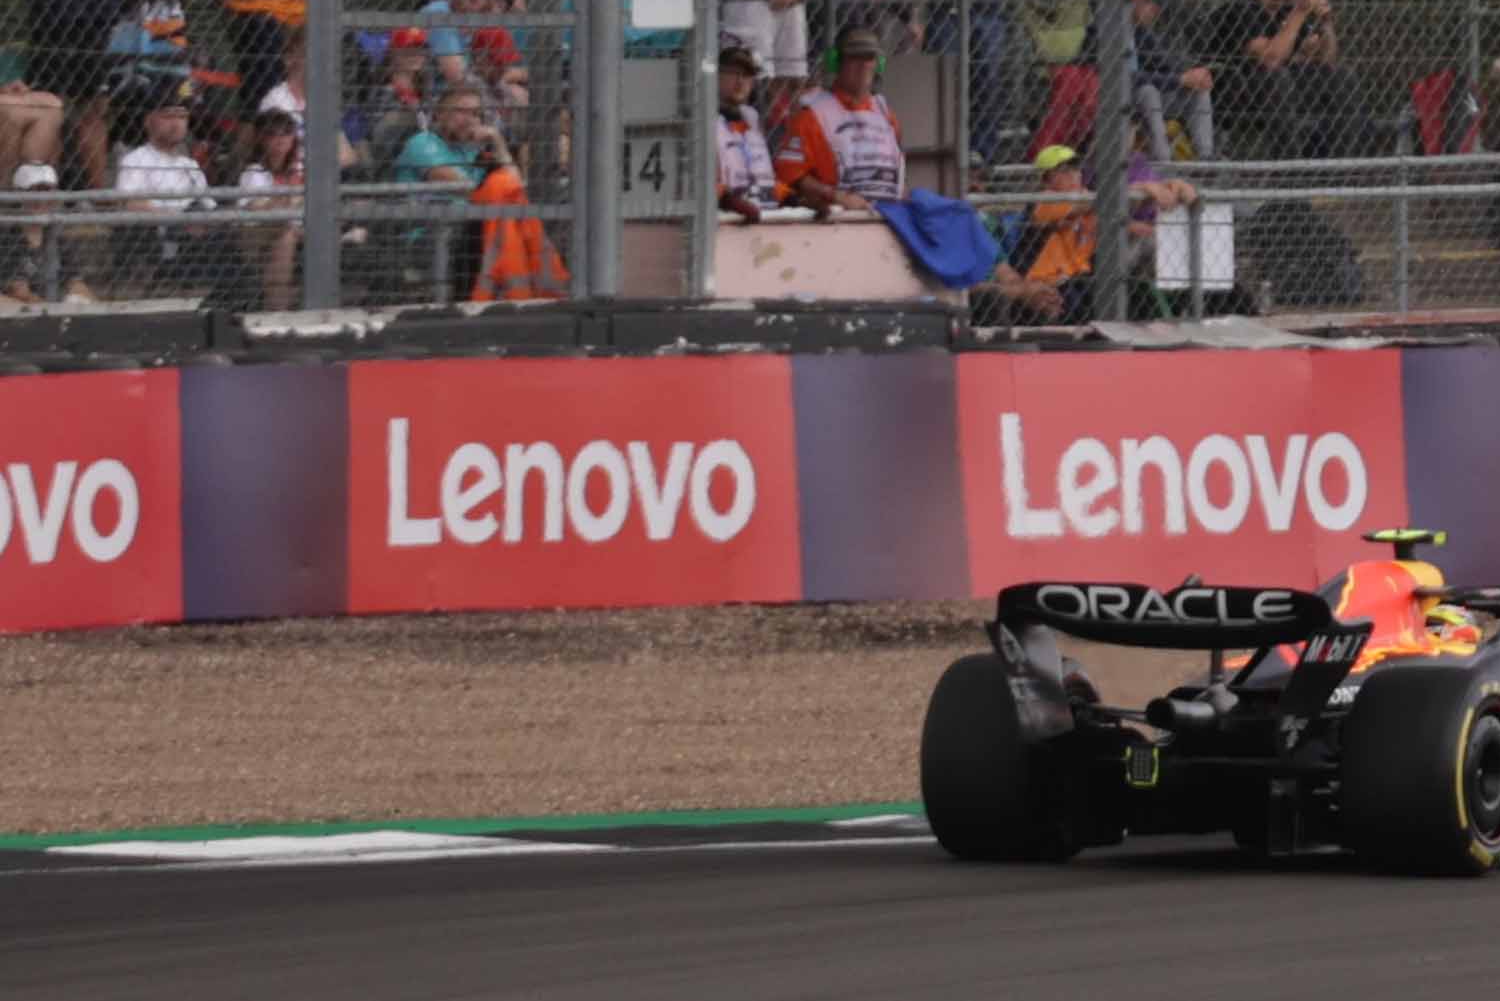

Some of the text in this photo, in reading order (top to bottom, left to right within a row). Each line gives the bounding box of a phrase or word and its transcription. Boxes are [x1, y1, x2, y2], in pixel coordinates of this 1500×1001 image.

[0, 460, 138, 562] vo
[388, 418, 755, 545] Lenovo
[1000, 412, 1368, 539] Lenovo
[1035, 584, 1298, 627] ORACLE
